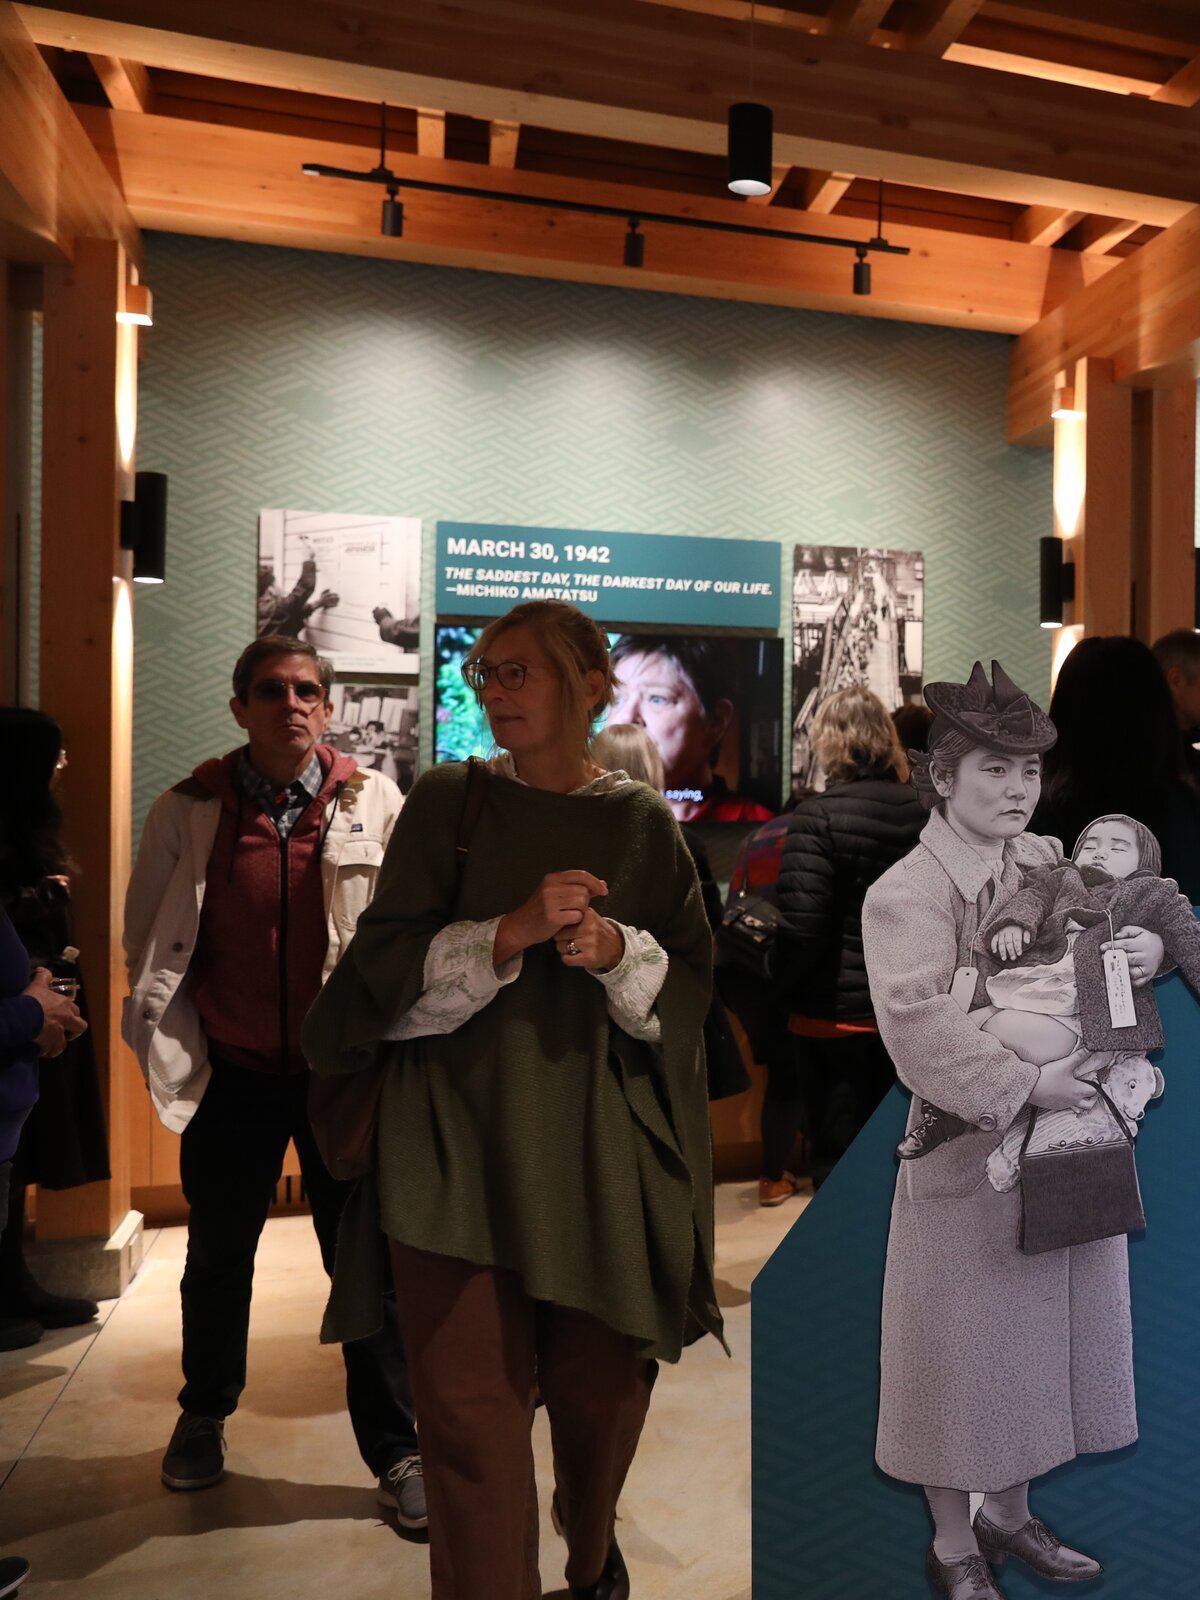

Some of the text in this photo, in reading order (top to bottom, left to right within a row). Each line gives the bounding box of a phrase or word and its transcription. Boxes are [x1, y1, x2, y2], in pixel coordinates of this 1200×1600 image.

[447, 537, 611, 564] MARCH 30, 1942
[445, 567, 772, 596] THE SADDEST DAY, THE DARKEST DAY OF OUR LIFE.
[521, 588, 598, 602] AMATATSU
[665, 788, 704, 802] saying,
